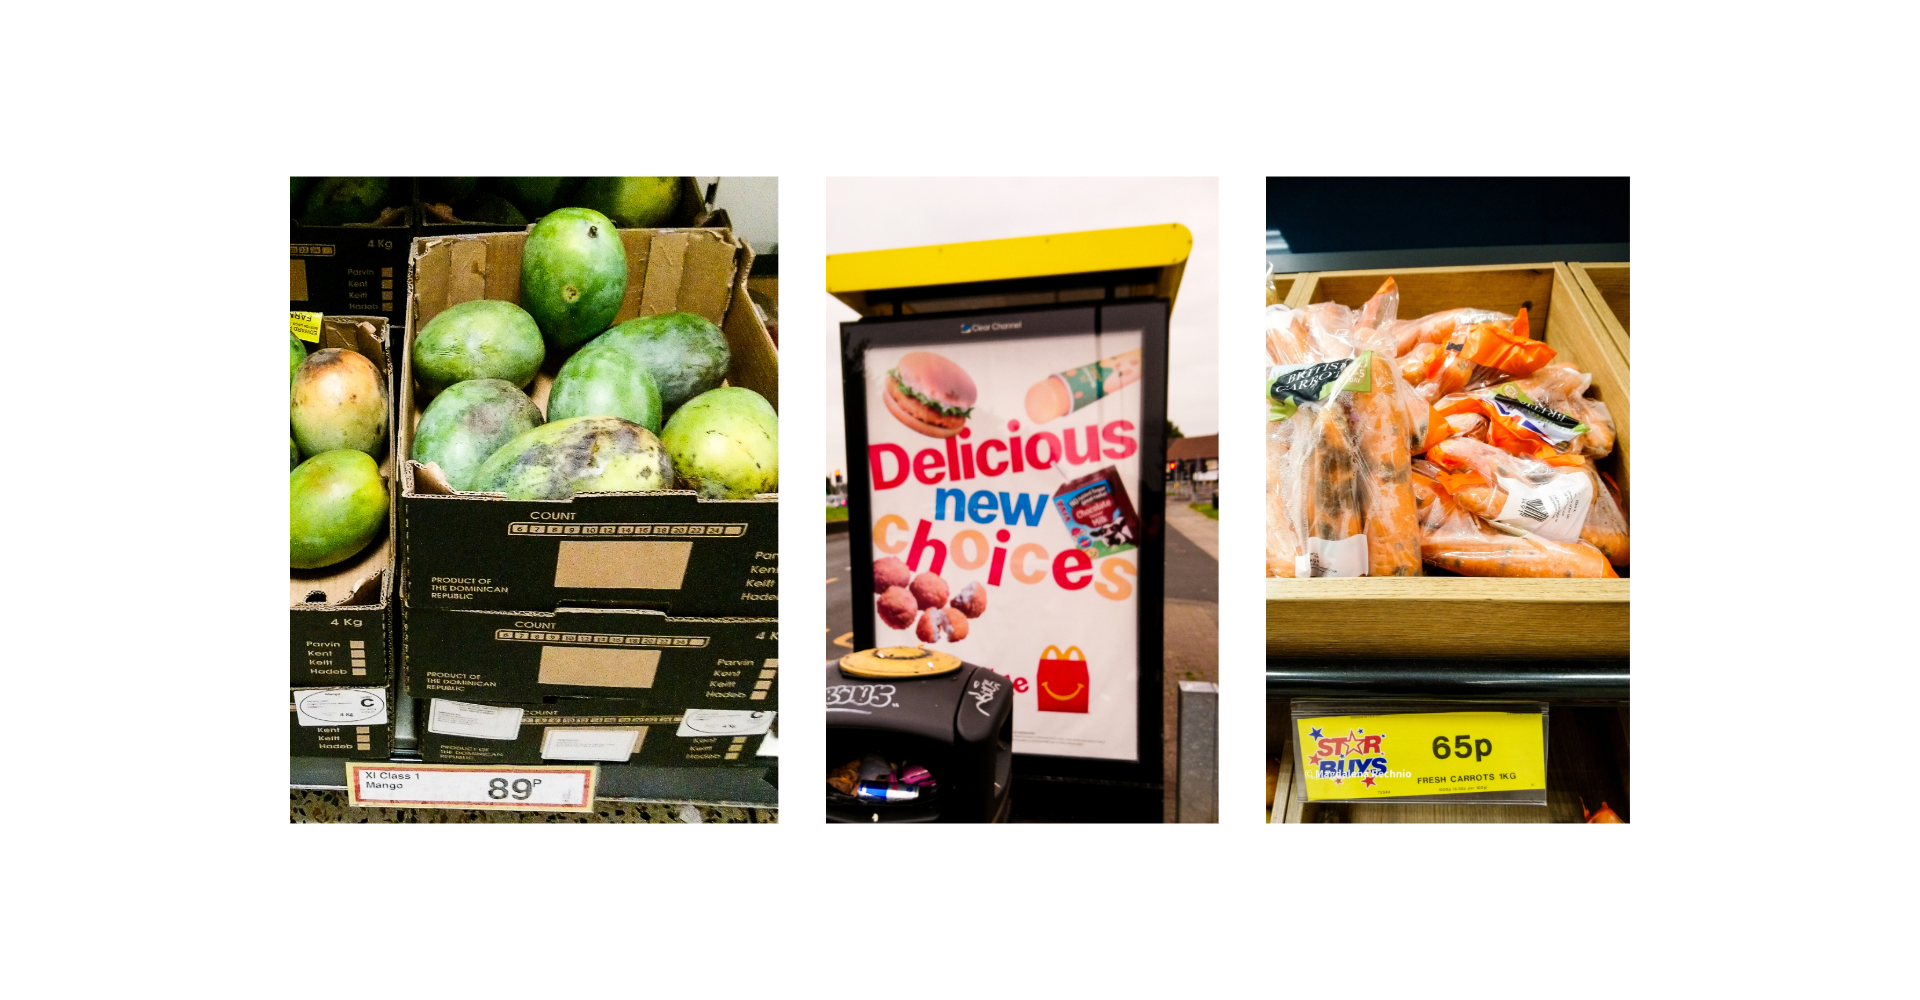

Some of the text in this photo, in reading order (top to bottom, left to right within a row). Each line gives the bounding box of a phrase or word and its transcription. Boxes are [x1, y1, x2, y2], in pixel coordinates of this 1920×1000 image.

[377, 239, 393, 250] Kg
[347, 268, 375, 276] Parvin
[348, 280, 368, 288] Kent
[971, 320, 1023, 332] Clear Channel
[868, 419, 1138, 491] Delicious
[934, 487, 1050, 527] new
[1075, 498, 1113, 520] Chocolate
[530, 511, 577, 520] COUNT
[873, 514, 1138, 602] choices
[431, 576, 475, 584] PRODUCT
[449, 585, 509, 594] DOMINICAN
[431, 592, 474, 600] REPUBLIC
[330, 618, 363, 628] 4 Kg
[514, 621, 557, 630] COUNT
[755, 631, 766, 640] 4
[306, 640, 341, 648] Parvin
[717, 658, 755, 666] Parvin
[426, 671, 467, 680] PRODUCT
[443, 678, 497, 688] DOMINICAN
[426, 684, 465, 692] REPUBLIC
[360, 698, 375, 708] C
[1432, 734, 1493, 763] 65p
[1318, 757, 1388, 779] BUYS
[379, 771, 411, 780] Class
[1417, 772, 1517, 785] FRESH CARROTS 1KG
[365, 781, 404, 790] Mango
